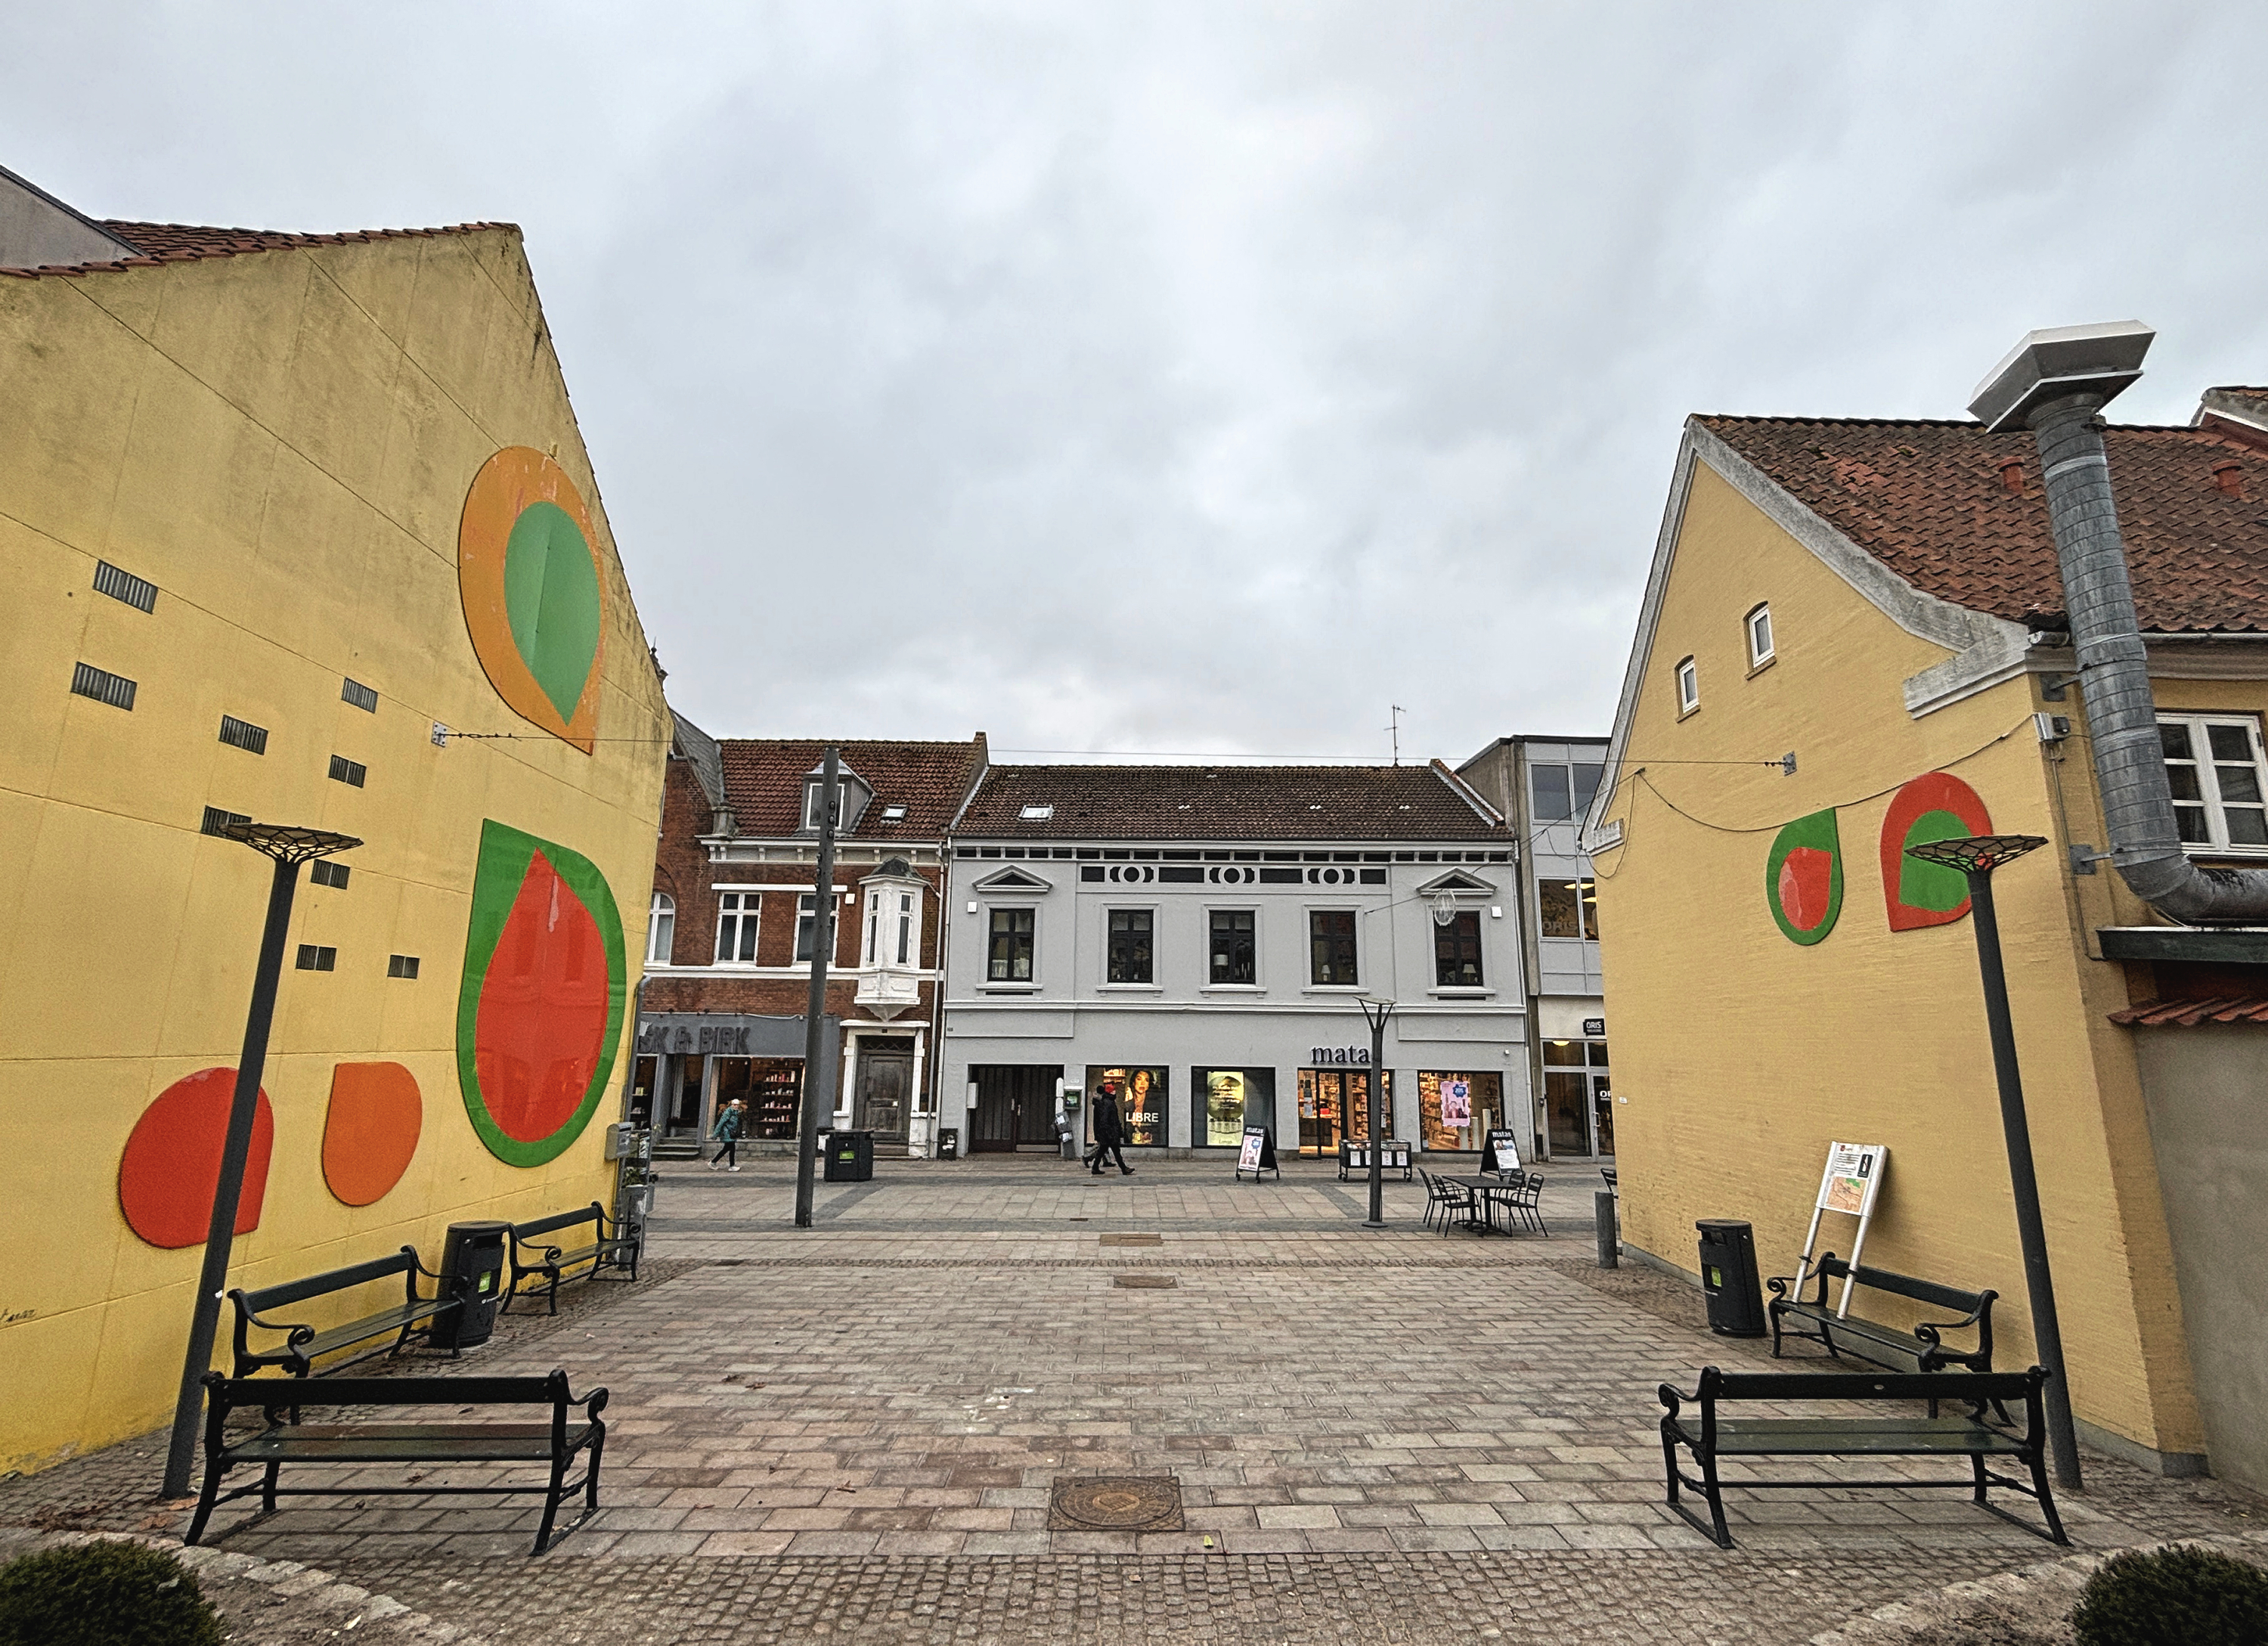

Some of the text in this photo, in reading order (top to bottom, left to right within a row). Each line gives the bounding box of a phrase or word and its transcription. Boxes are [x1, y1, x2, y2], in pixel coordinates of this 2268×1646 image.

[1586, 1021, 1602, 1029] ORIS
[699, 1026, 751, 1055] BIRK
[1311, 1045, 1371, 1064] mata
[1125, 1111, 1159, 1123] LIBRE
